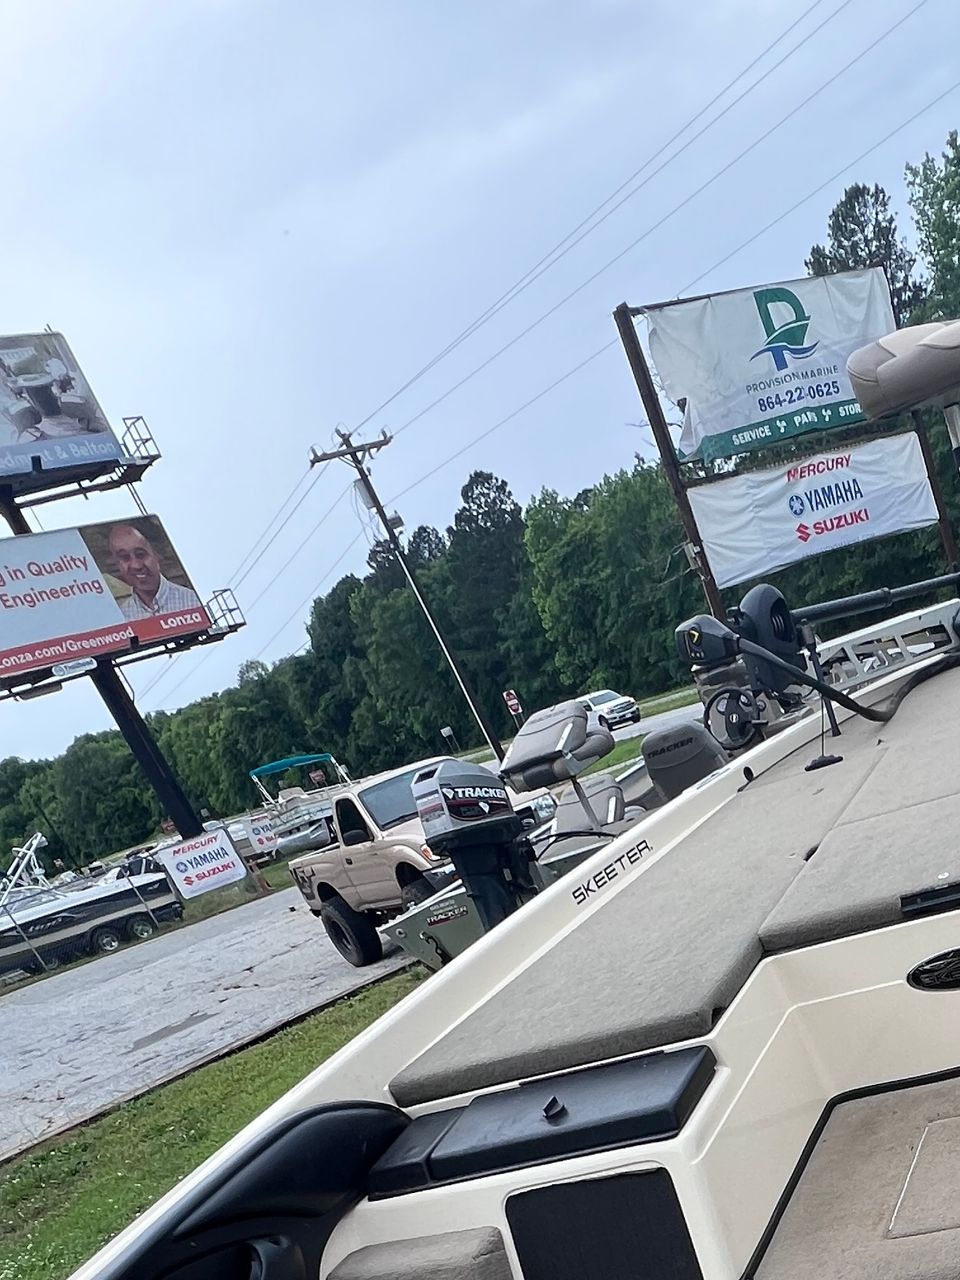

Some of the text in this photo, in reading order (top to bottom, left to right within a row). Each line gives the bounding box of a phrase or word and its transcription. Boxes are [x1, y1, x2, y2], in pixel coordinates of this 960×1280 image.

[758, 381, 840, 412] 864-22-0625
[732, 425, 771, 446] SERVICE
[839, 403, 862, 417] STOR
[68, 441, 116, 457] Belton
[787, 454, 851, 482] MERCURY
[804, 478, 863, 512] YAMAHA
[813, 508, 869, 535] SUZUKI
[7, 566, 25, 581] in
[27, 555, 89, 577] Quality
[2, 578, 104, 609] Engineering
[160, 611, 202, 629] Lonza
[648, 737, 693, 759] TRACKER
[172, 834, 218, 856] MERCURY
[186, 846, 229, 869] YAMAHA
[195, 861, 235, 881] SUZUKI
[572, 839, 651, 905] SKEETER
[426, 905, 467, 923] TRACKER
